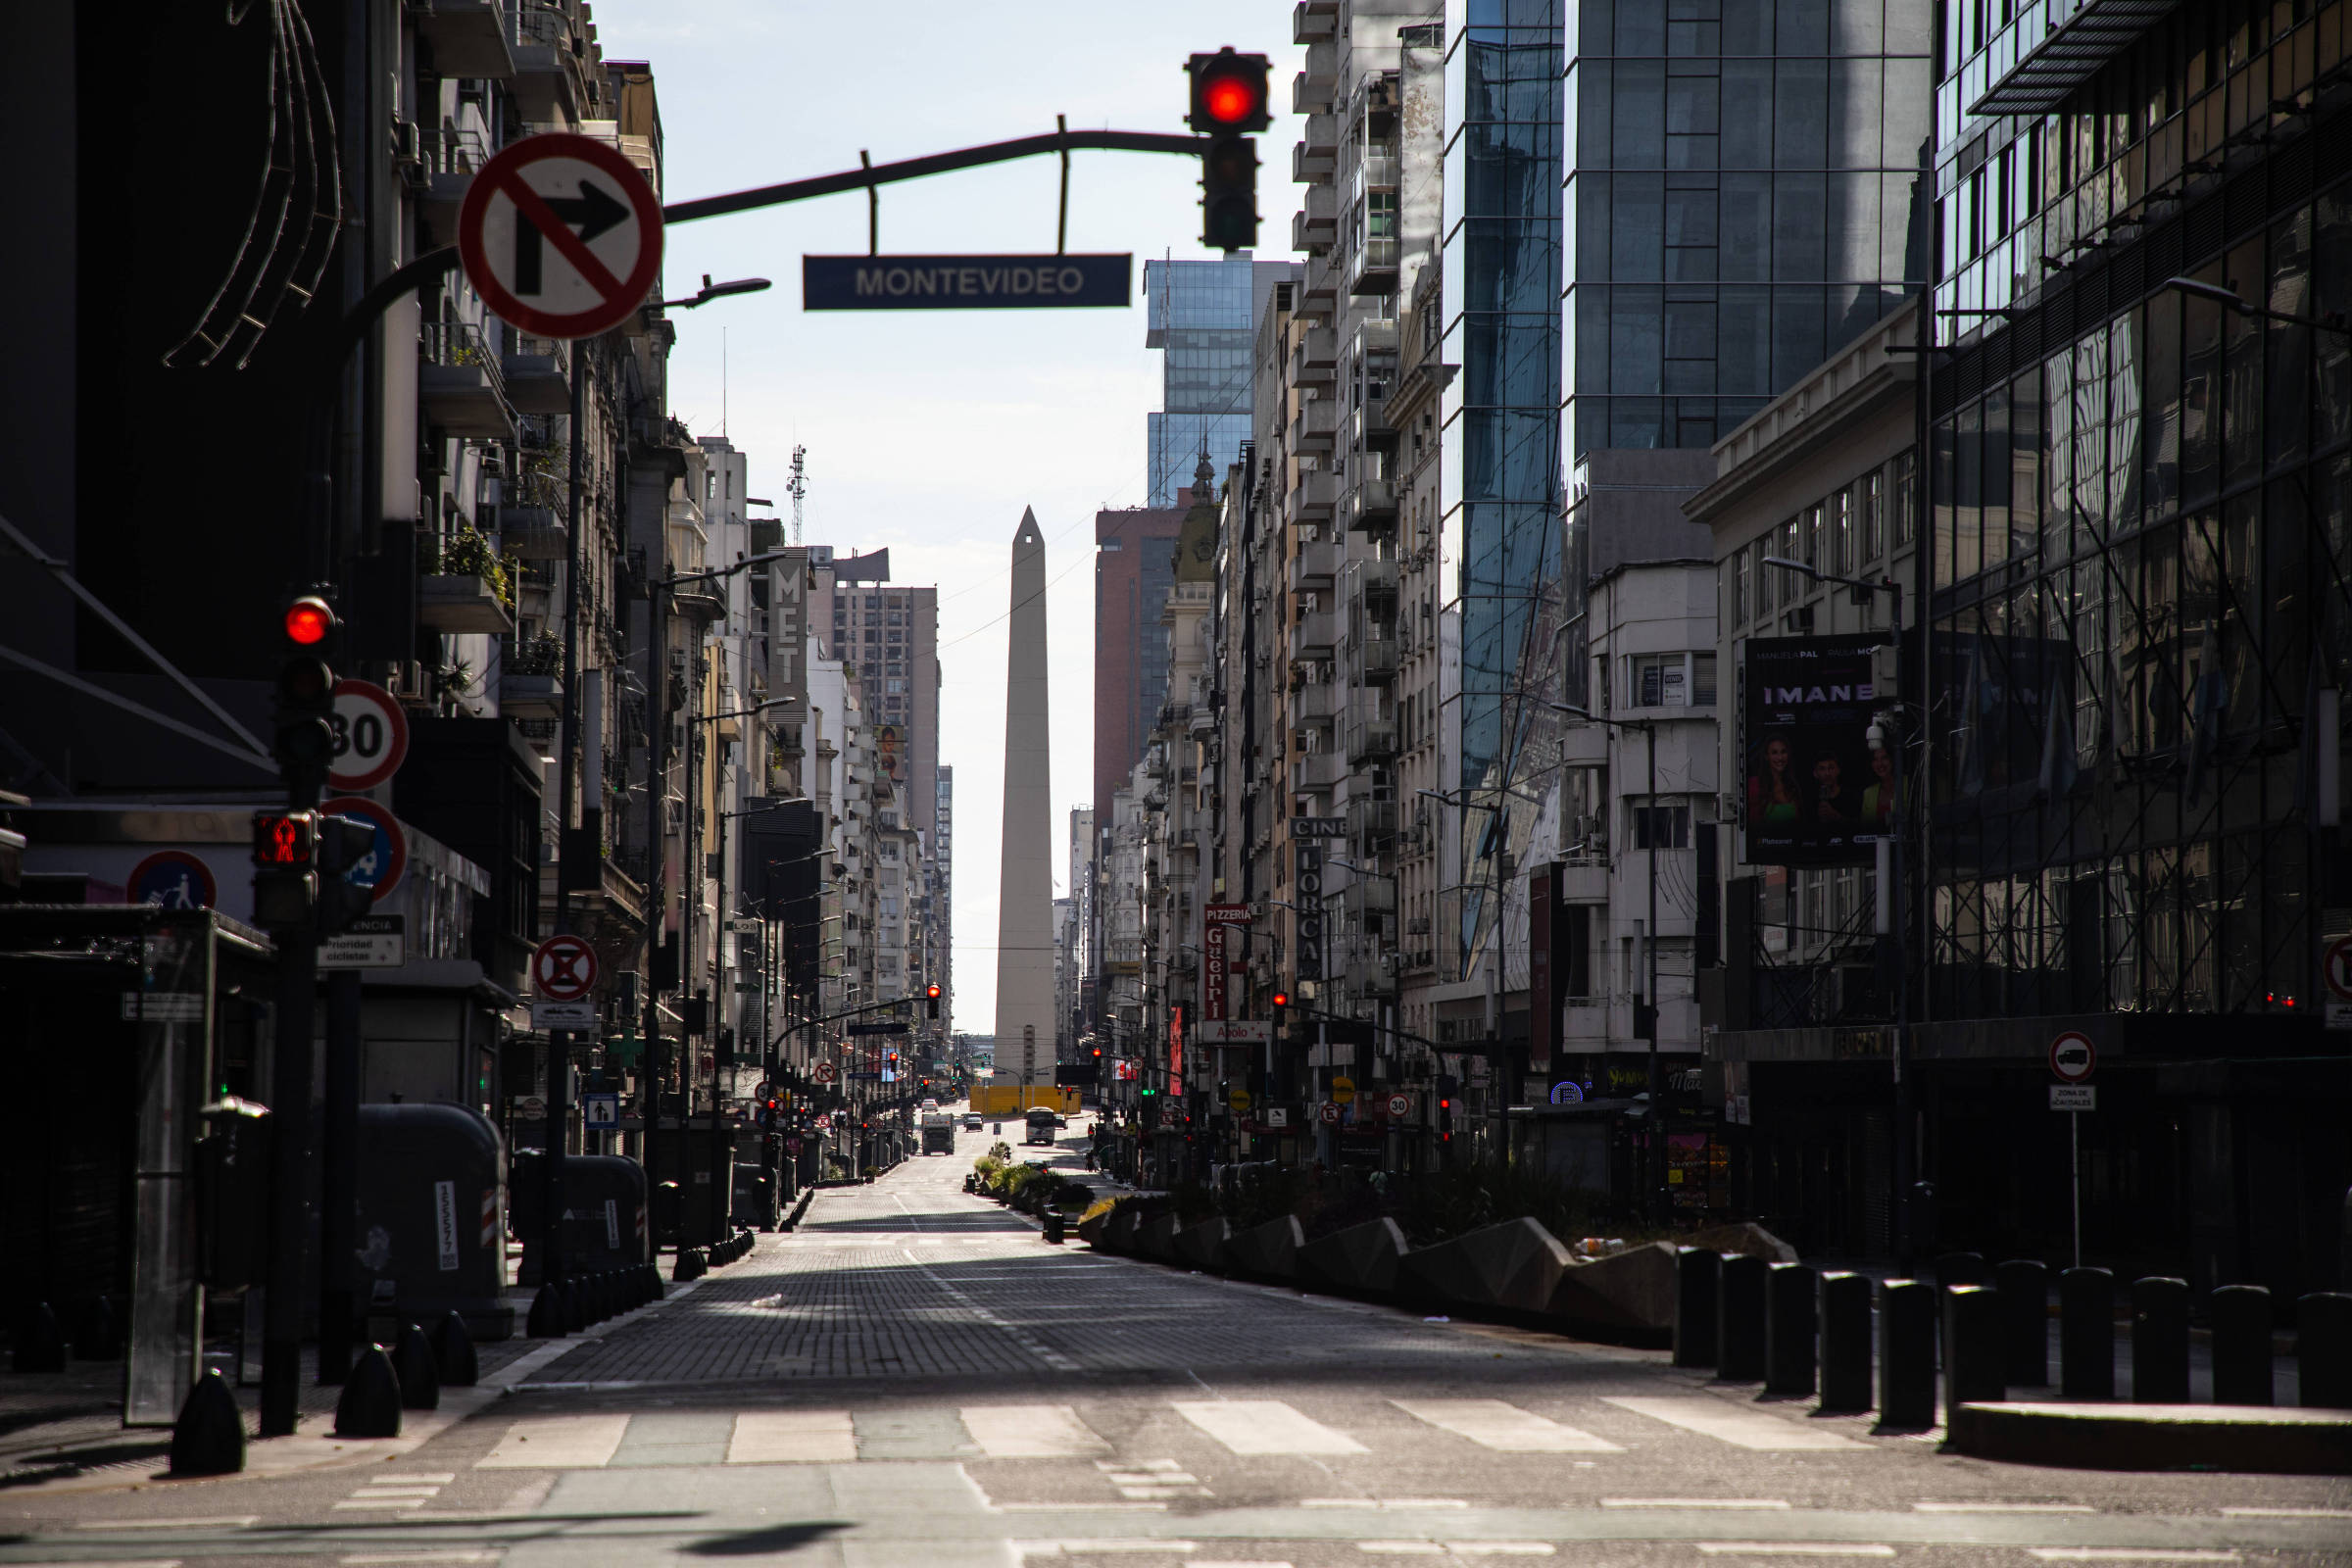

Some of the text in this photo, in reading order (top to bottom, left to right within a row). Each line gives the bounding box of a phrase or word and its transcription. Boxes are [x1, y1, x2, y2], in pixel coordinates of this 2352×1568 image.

[855, 266, 1084, 297] MONTEVIDEO
[774, 564, 801, 685] MET
[1206, 908, 1251, 921] PIZZERIA
[1299, 851, 1321, 961] LORCA
[1391, 1100, 1406, 1111] 30
